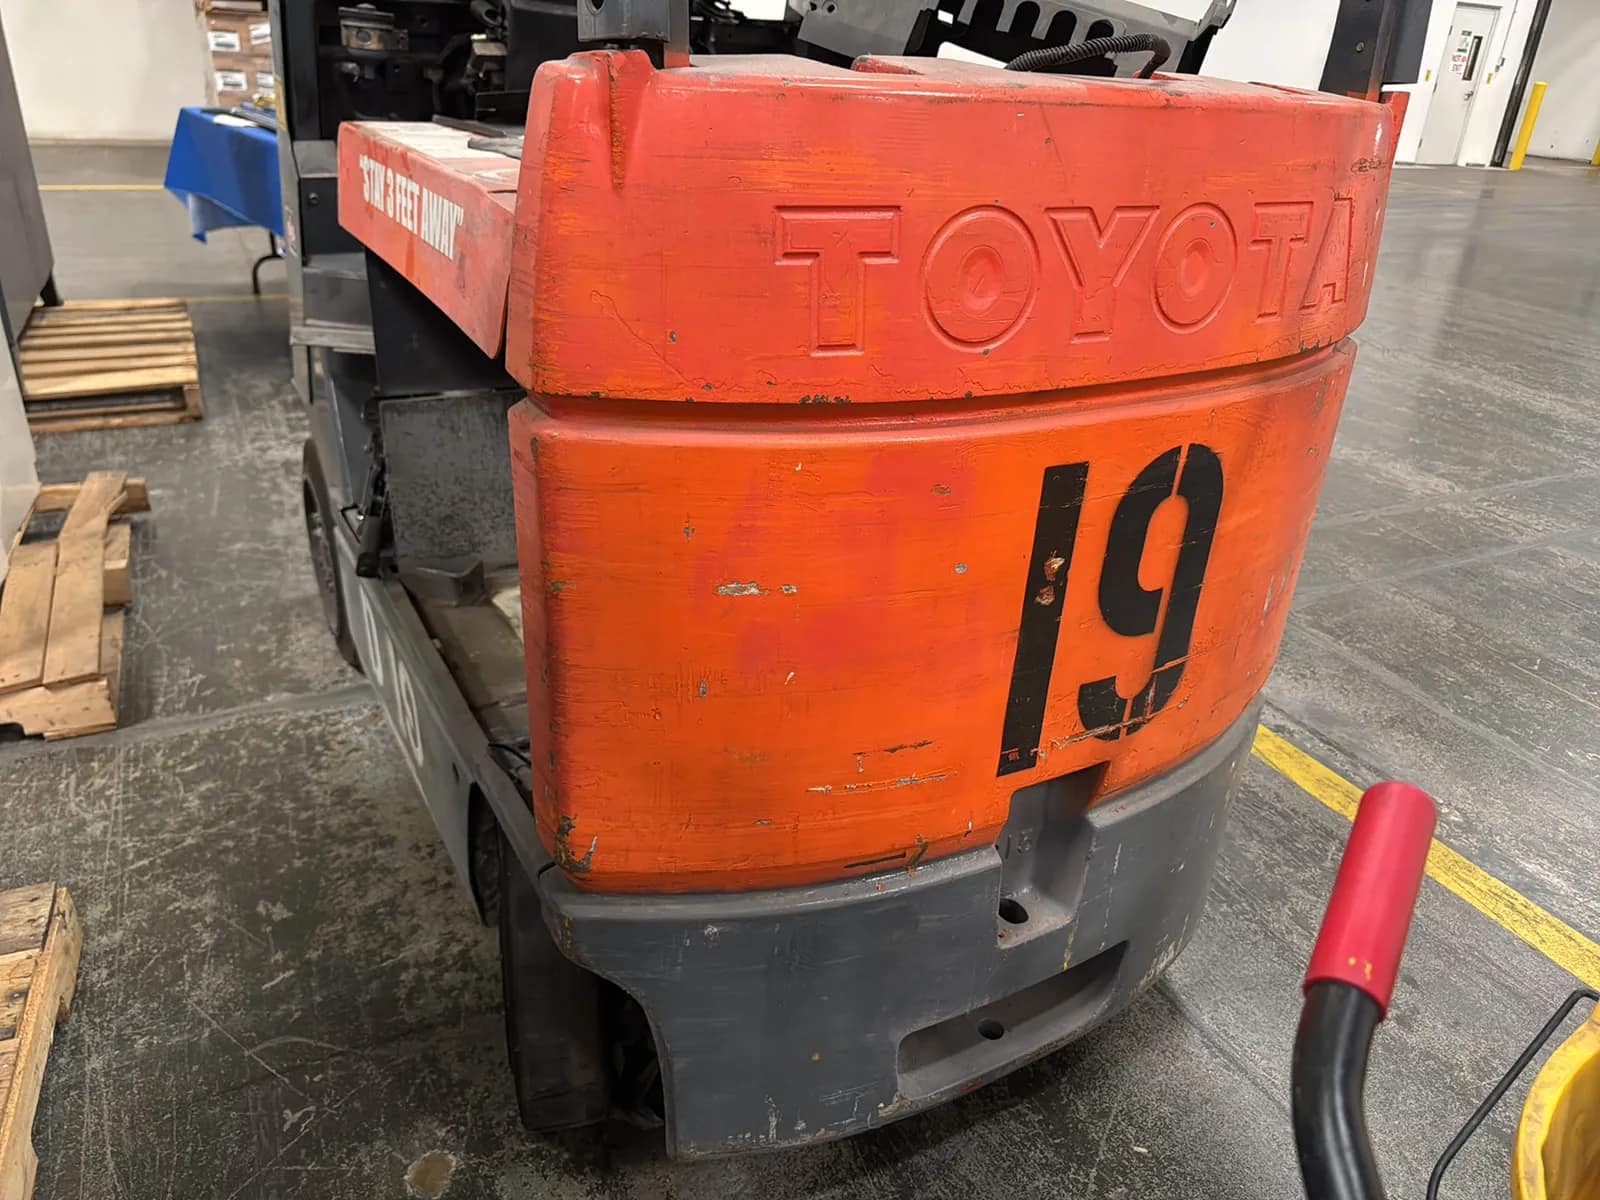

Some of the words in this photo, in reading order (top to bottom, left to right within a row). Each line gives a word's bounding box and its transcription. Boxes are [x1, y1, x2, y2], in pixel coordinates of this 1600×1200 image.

[386, 168, 394, 218] 3
[396, 173, 419, 235] FEET
[774, 197, 1353, 357] TOYOTA
[996, 443, 1224, 778] 19
